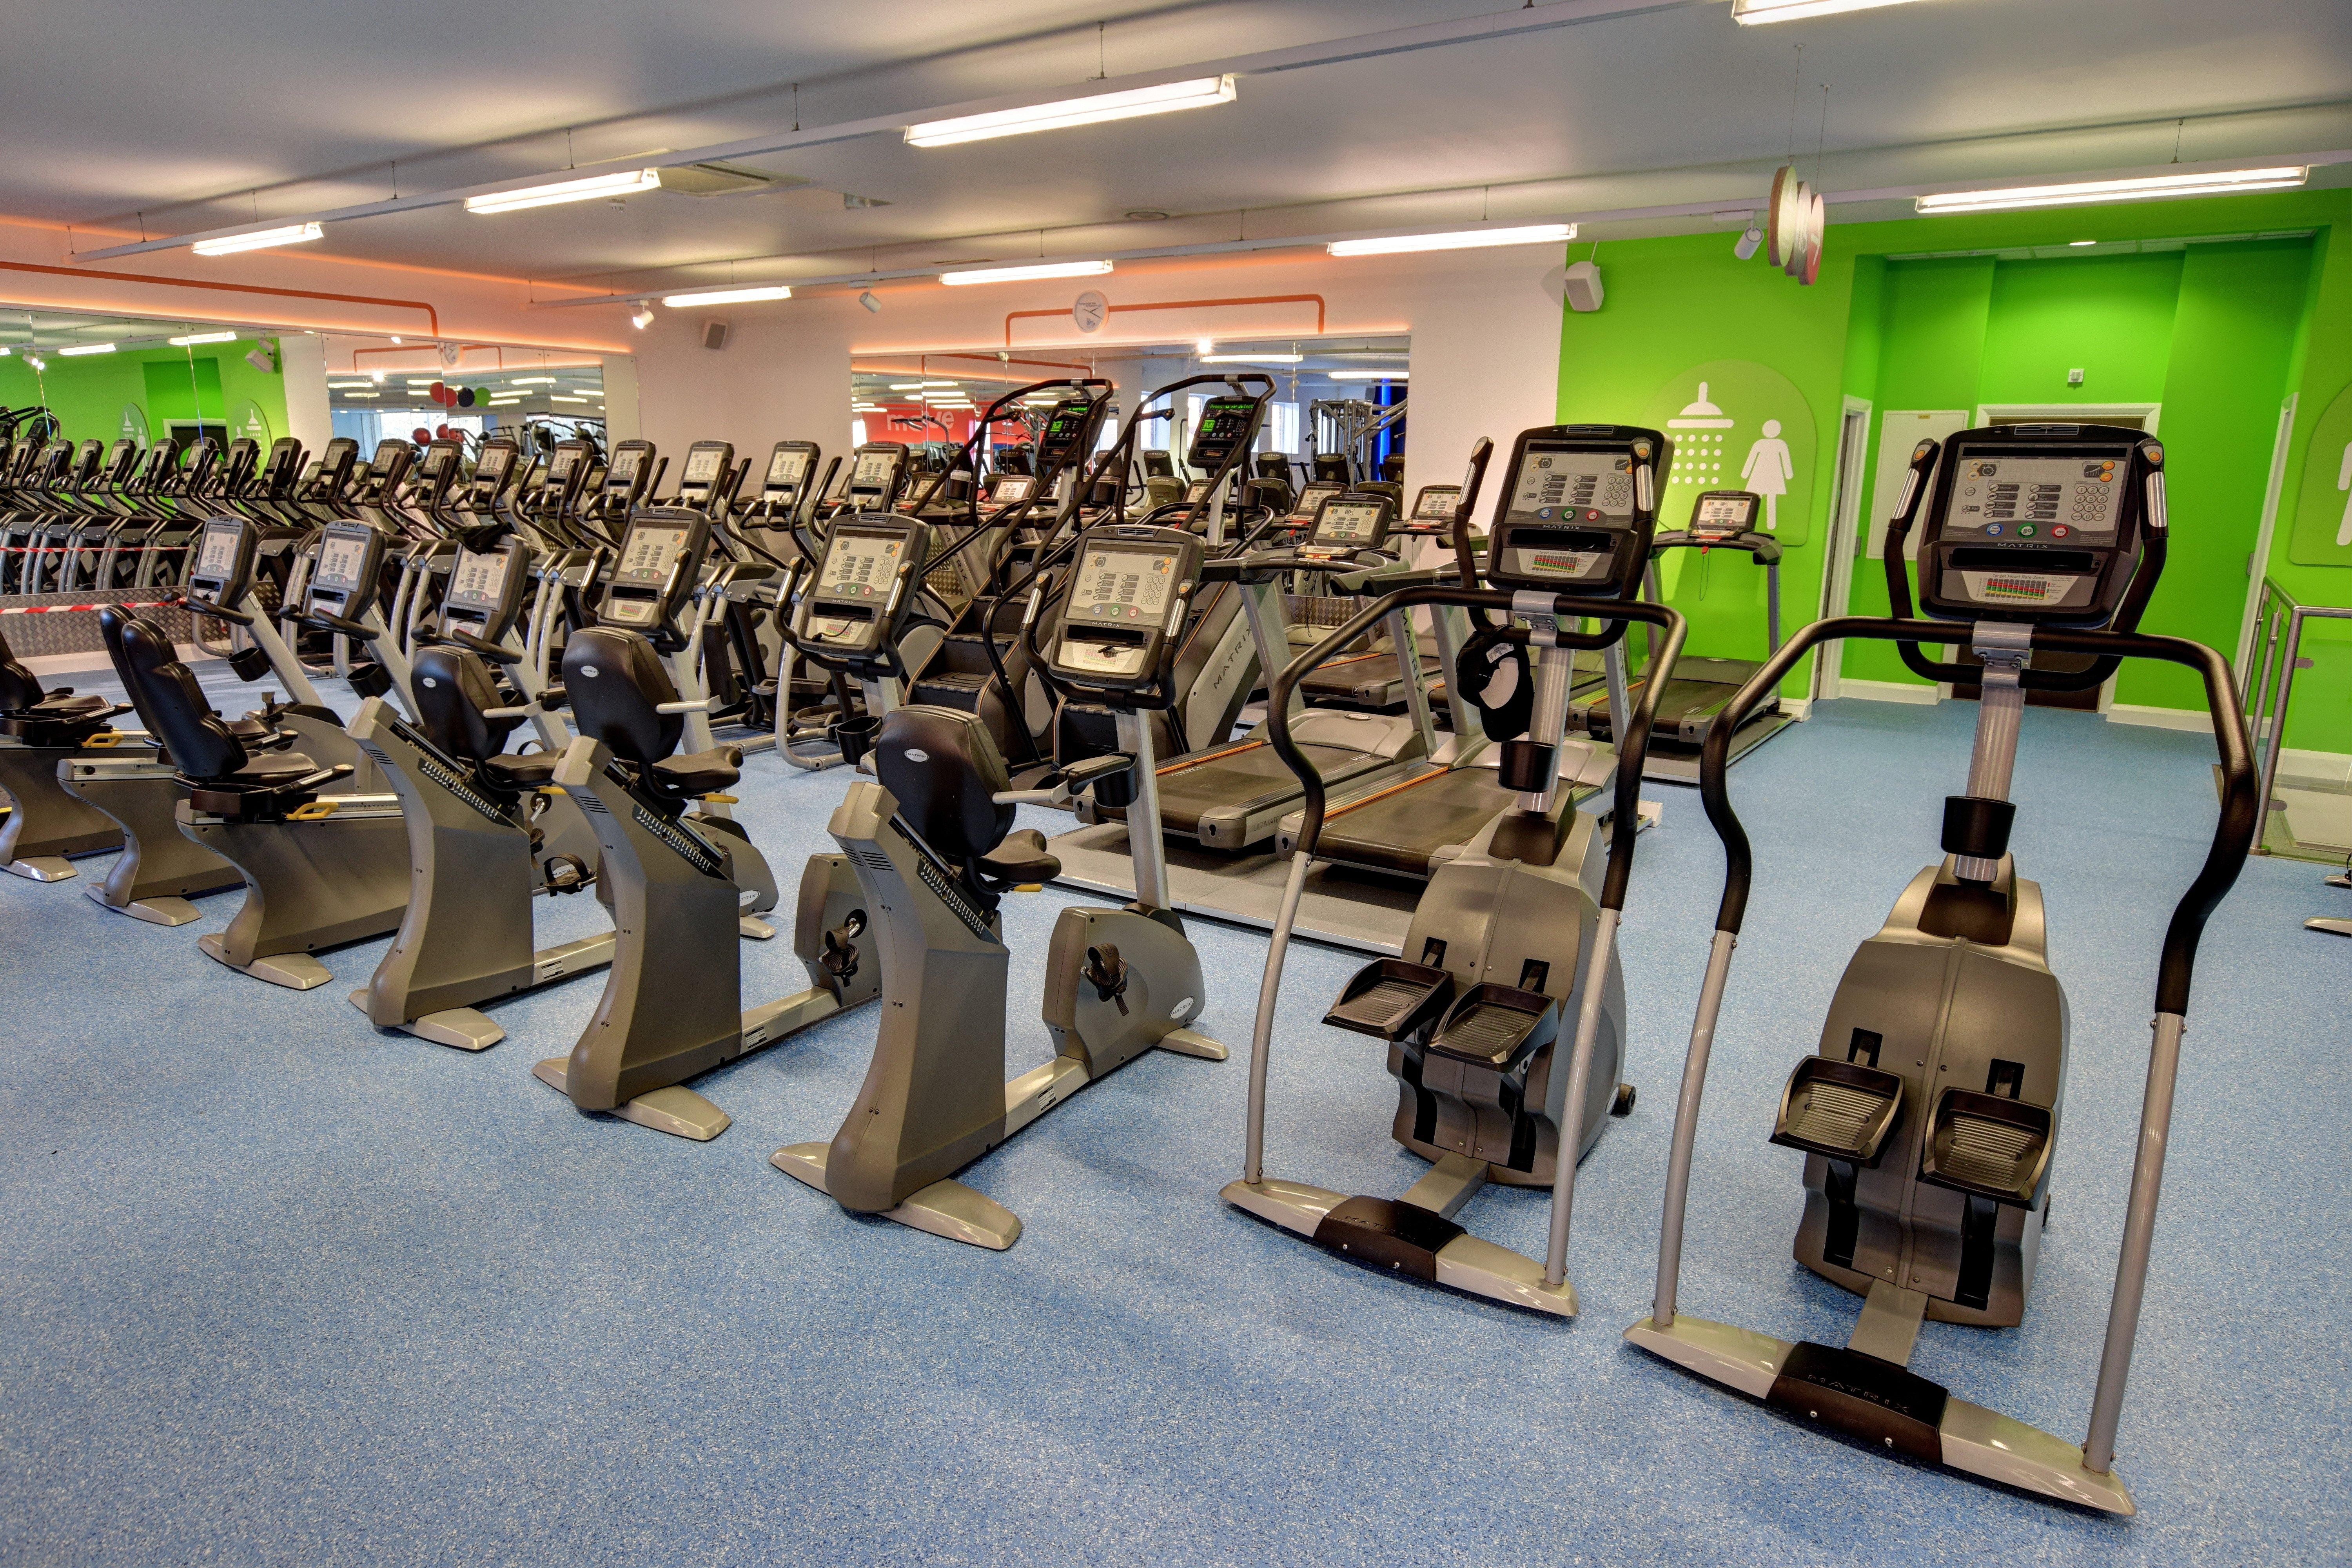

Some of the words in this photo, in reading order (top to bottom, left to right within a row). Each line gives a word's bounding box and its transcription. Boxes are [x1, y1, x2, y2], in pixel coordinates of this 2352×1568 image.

[1214, 625, 1251, 690] MATRIX
[1172, 1002, 1191, 1015] MATRIX
[1808, 1374, 1909, 1413] MATRIX
